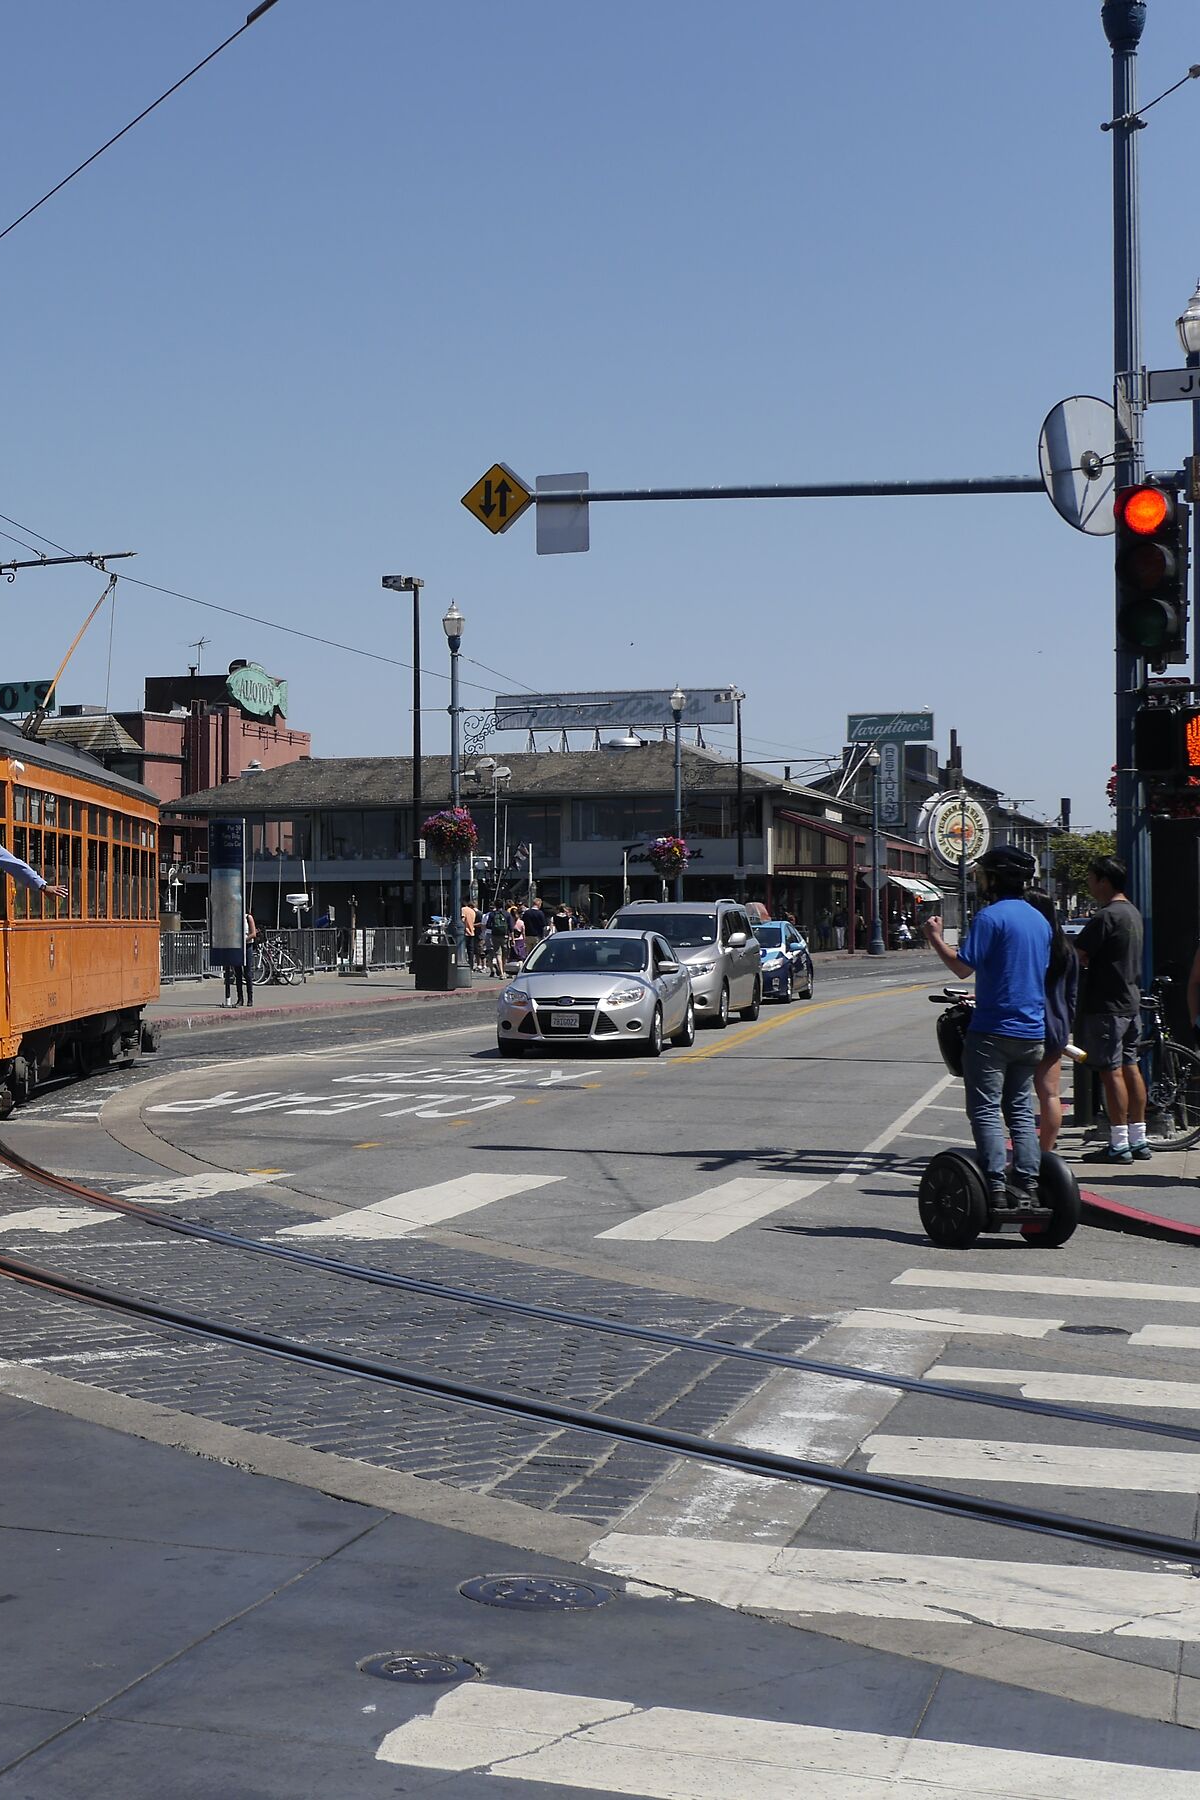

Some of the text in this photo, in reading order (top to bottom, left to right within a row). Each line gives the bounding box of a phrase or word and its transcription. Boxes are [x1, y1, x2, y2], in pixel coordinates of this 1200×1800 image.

[850, 717, 930, 739] Tarantino's
[885, 747, 897, 818] RESTAURANT
[331, 1068, 602, 1087] KEEP
[144, 1090, 516, 1119] CLEAR
